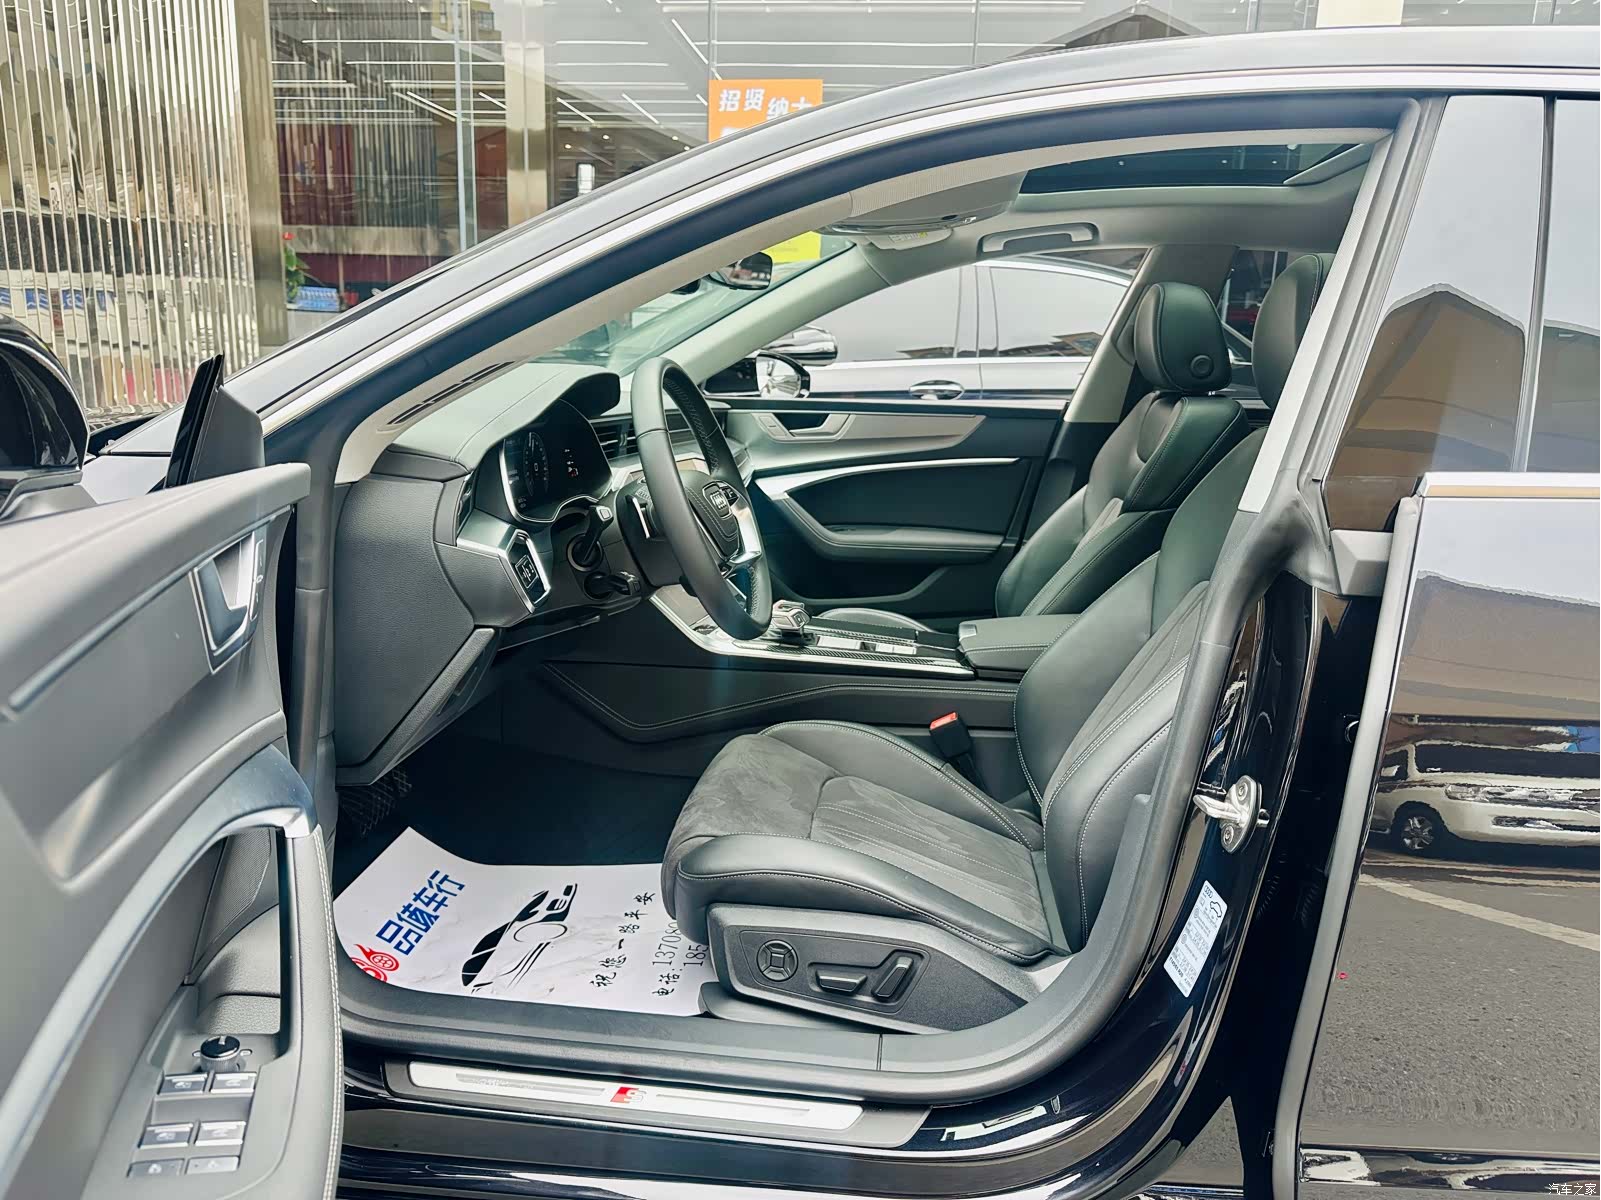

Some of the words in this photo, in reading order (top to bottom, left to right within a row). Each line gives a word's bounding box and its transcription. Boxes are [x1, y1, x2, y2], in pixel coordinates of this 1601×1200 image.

[590, 892, 656, 987] 祝您一路平安
[683, 945, 709, 966] 185
